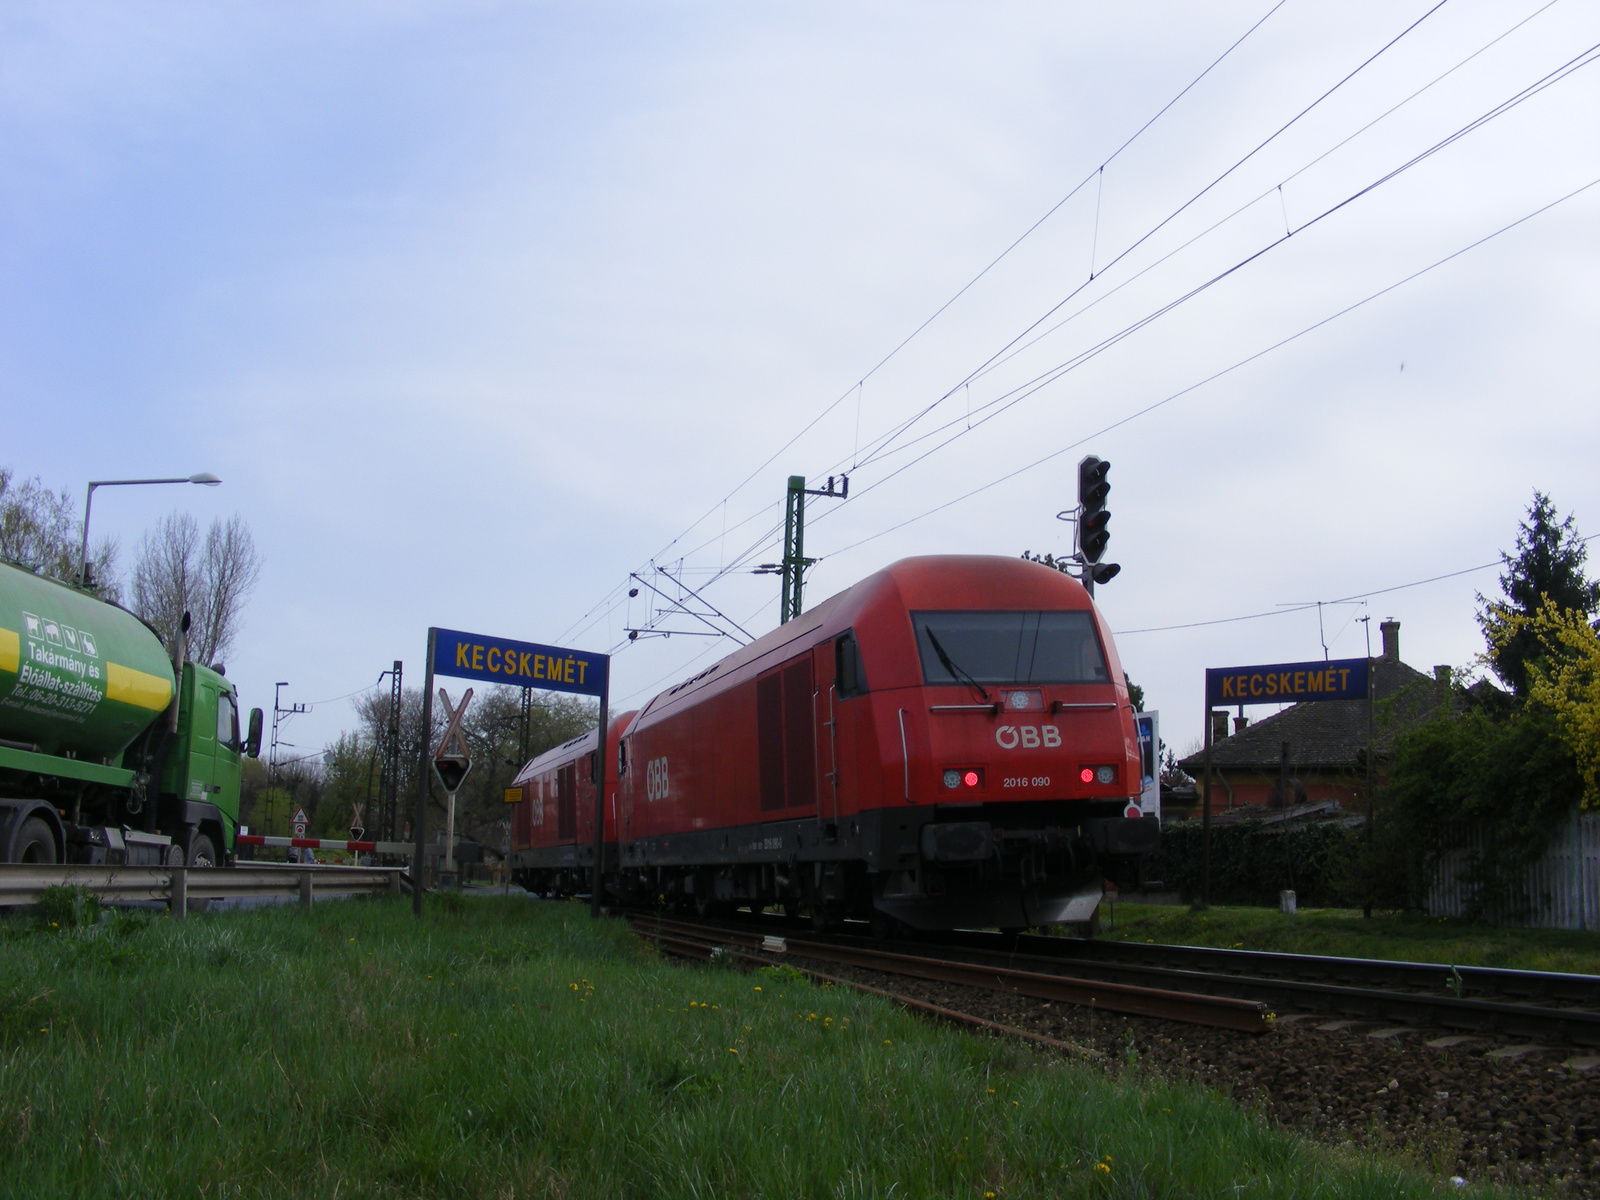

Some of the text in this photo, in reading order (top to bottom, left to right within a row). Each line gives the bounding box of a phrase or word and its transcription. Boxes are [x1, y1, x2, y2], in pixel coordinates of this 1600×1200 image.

[28, 641, 100, 679] Takármány és
[456, 642, 588, 684] KECSKEMÉT
[1222, 665, 1350, 697] KECSKEMÉT
[996, 725, 1062, 749] ÖBB
[647, 756, 669, 802] ÖBB
[1003, 776, 1051, 788] 2016 090
